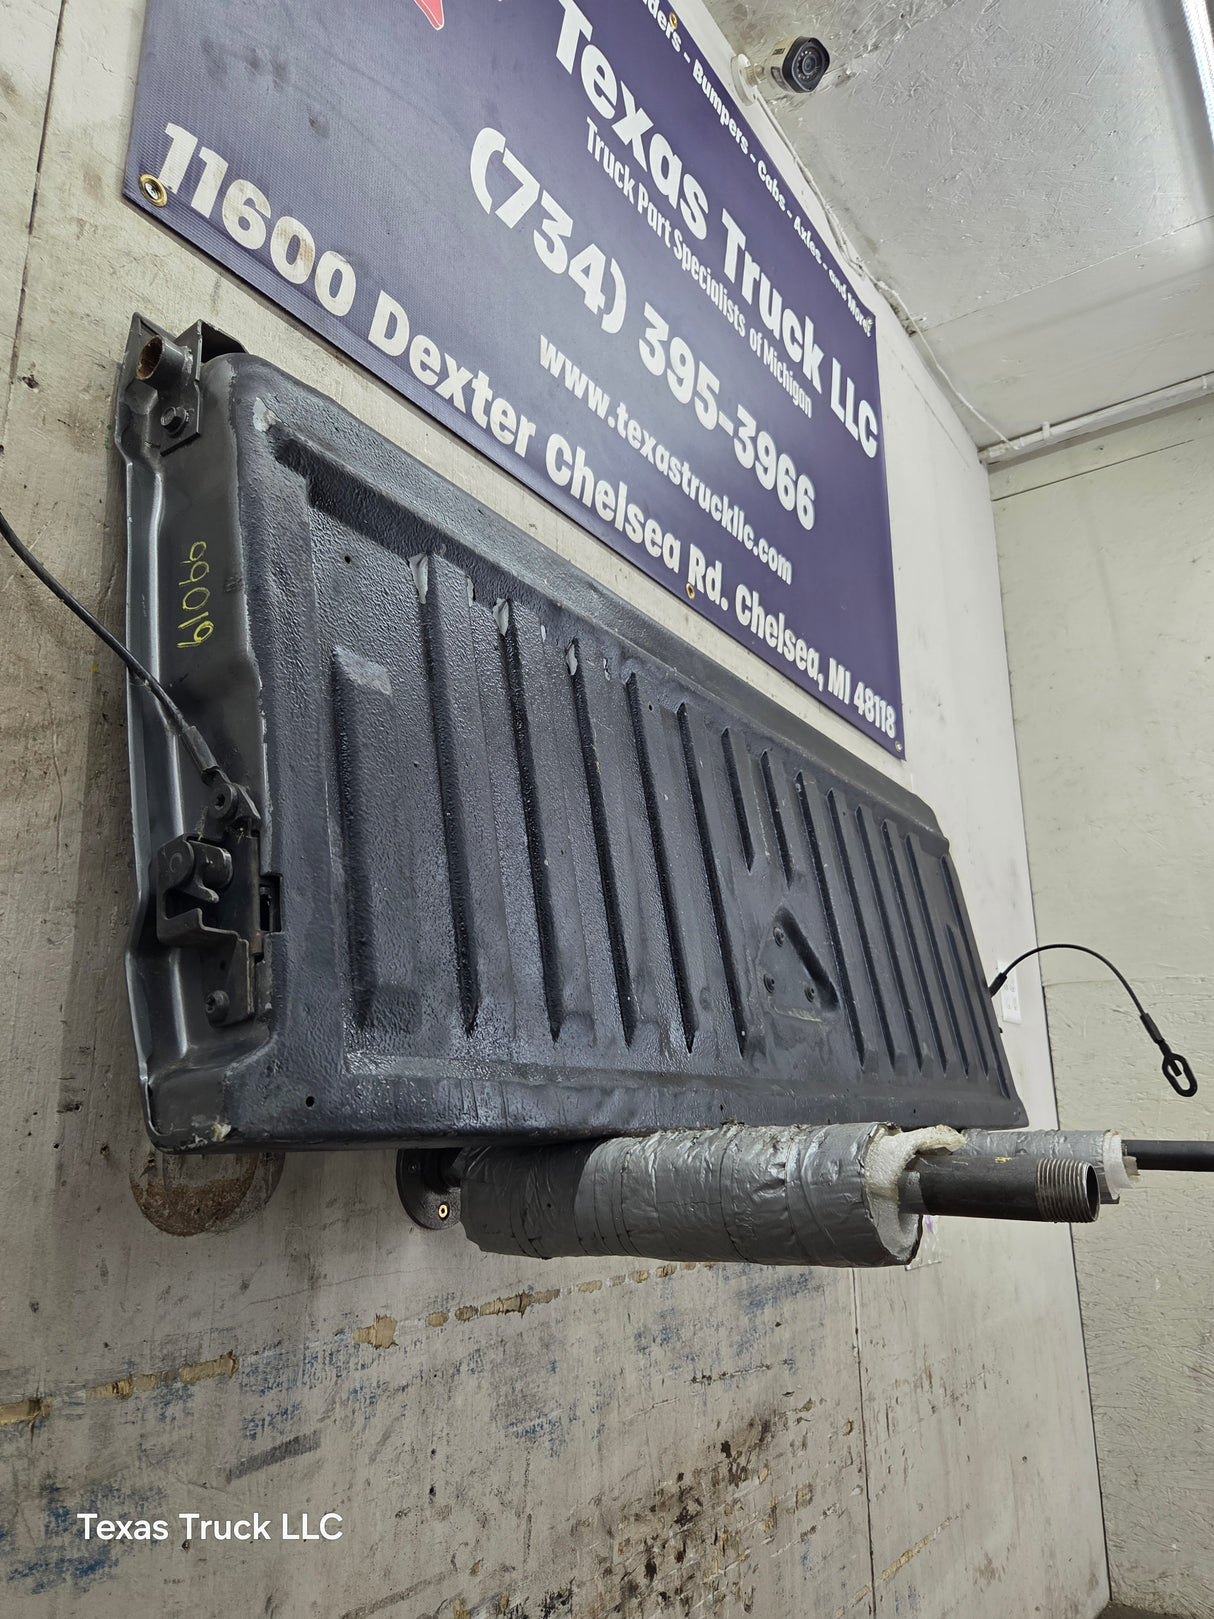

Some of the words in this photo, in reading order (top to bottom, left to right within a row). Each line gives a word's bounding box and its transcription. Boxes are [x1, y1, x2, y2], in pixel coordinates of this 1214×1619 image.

[556, 0, 709, 240] Texas
[721, 208, 825, 394] Truck
[830, 357, 879, 458] LLC
[587, 116, 635, 205] Truck
[637, 182, 672, 248] Part
[673, 228, 746, 338] Specialists
[749, 327, 763, 358] of
[763, 338, 812, 419] Michigan
[642, 0, 682, 52] ders
[692, 59, 749, 155] Bumpers
[757, 160, 786, 212] Cabs
[793, 215, 822, 264] Axles
[828, 269, 847, 301] and
[157, 122, 357, 317] 11600
[367, 289, 537, 458] Dexter
[546, 433, 681, 573] Chelsea
[687, 543, 729, 611] Rd.
[735, 584, 824, 692] Chelsea,
[828, 657, 851, 704] MI
[853, 681, 896, 739] 48118
[469, 127, 627, 334] (734)
[638, 302, 815, 531] 395-3966
[539, 334, 792, 585] www.texastruckllc.com
